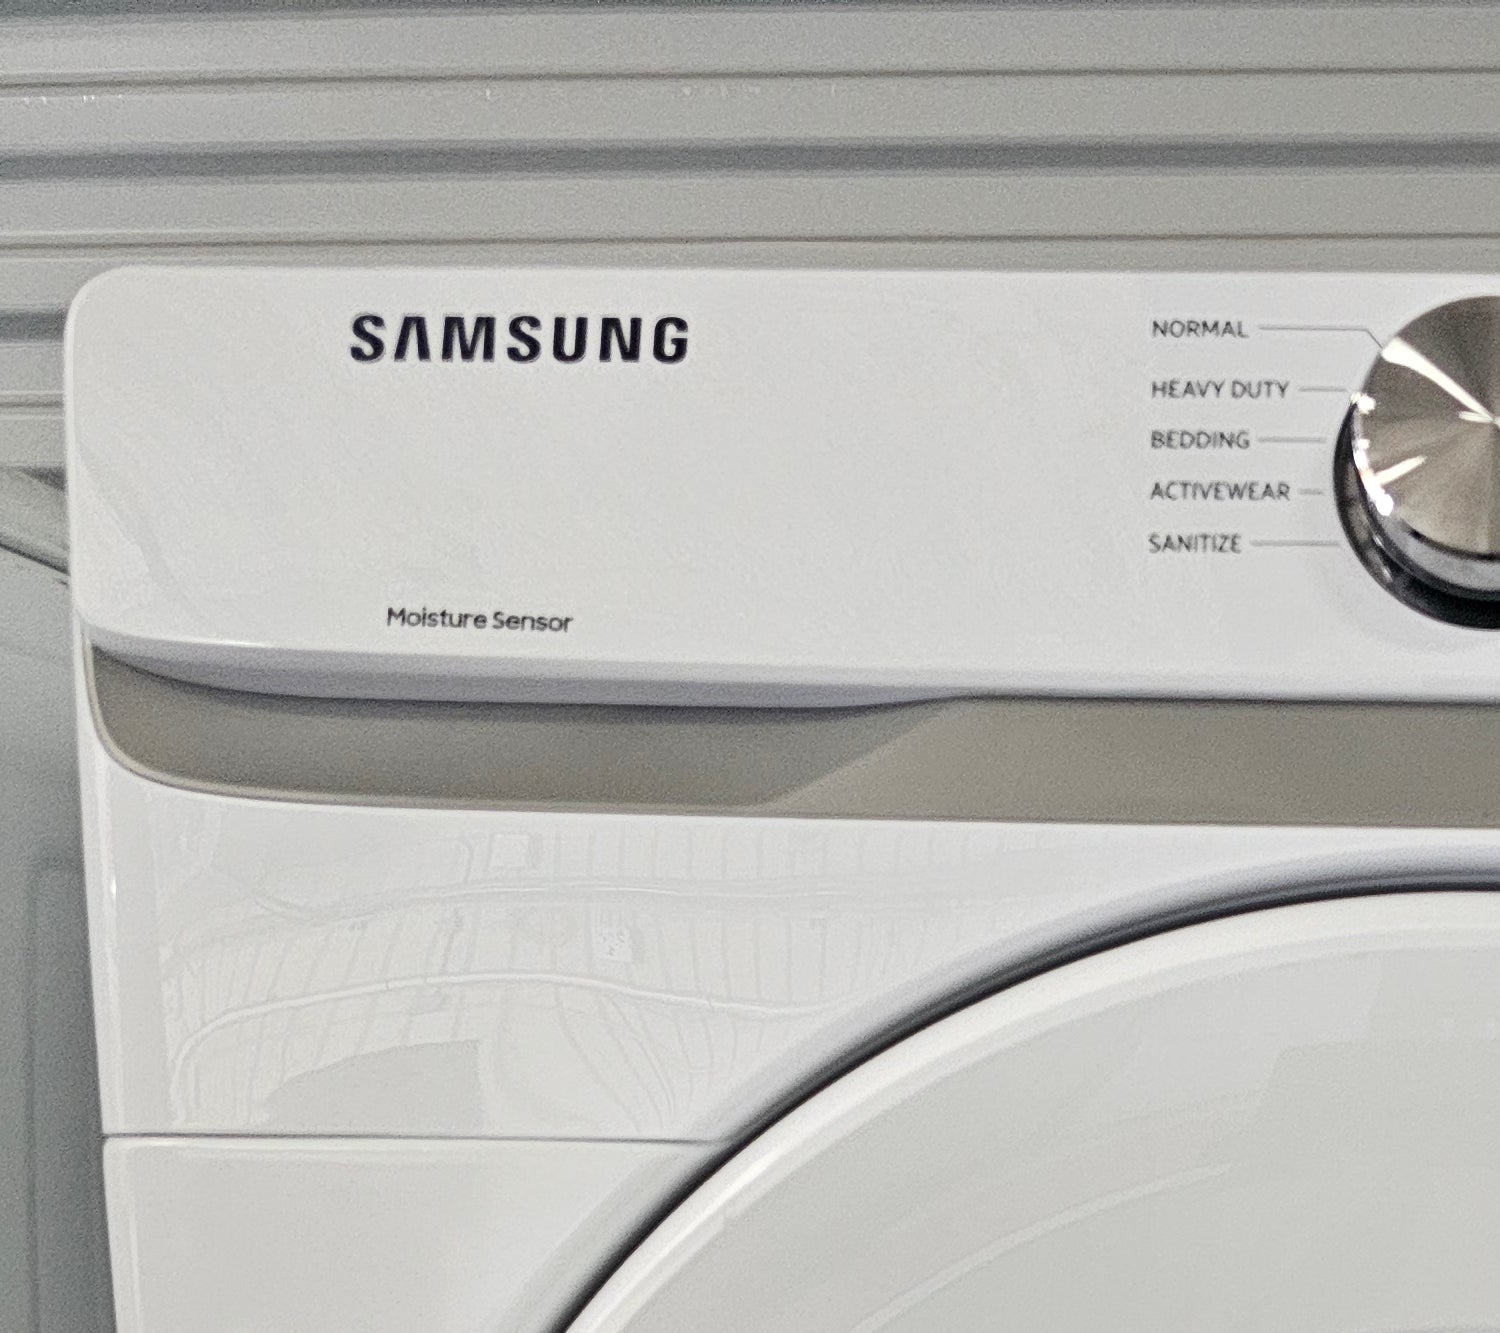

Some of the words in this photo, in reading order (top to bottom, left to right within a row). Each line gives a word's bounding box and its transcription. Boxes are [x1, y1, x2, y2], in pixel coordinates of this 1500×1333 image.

[350, 314, 689, 364] SAMSUNG
[1151, 320, 1249, 338] NORMAL
[1151, 379, 1225, 398] HEAVY
[1231, 380, 1290, 398] DUTY
[1151, 430, 1250, 449] BEDDING
[1150, 480, 1290, 500] ACTIVEWEAR
[1149, 532, 1242, 553] SANITIZE
[386, 607, 487, 629] Moisture
[493, 611, 573, 632] Sensor
